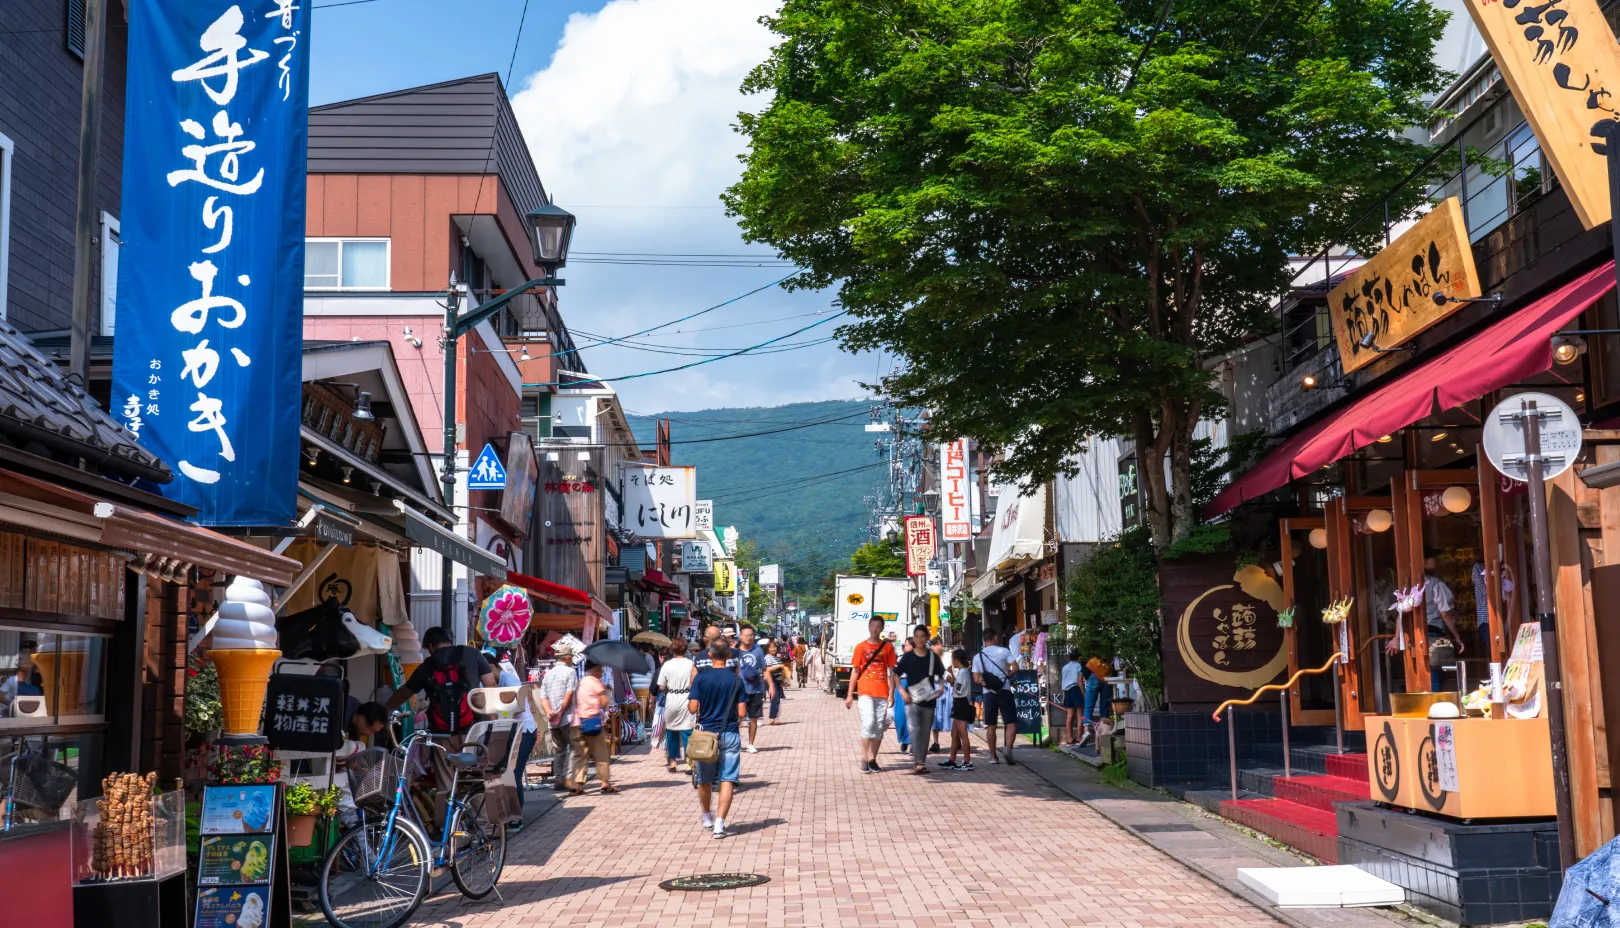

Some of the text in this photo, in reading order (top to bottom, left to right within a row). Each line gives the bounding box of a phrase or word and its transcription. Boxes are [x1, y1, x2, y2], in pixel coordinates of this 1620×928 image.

[167, 5, 270, 483] 手造りおかき
[146, 358, 162, 416] おかき処
[630, 473, 675, 487] そば処
[637, 502, 691, 529] にし川
[910, 528, 931, 546] 酒
[851, 611, 870, 620] クール
[1231, 603, 1257, 651] 蒟蒻
[1212, 607, 1230, 666] しゃぼん
[276, 693, 331, 714] 軽井沢
[273, 713, 330, 734] 物産館
